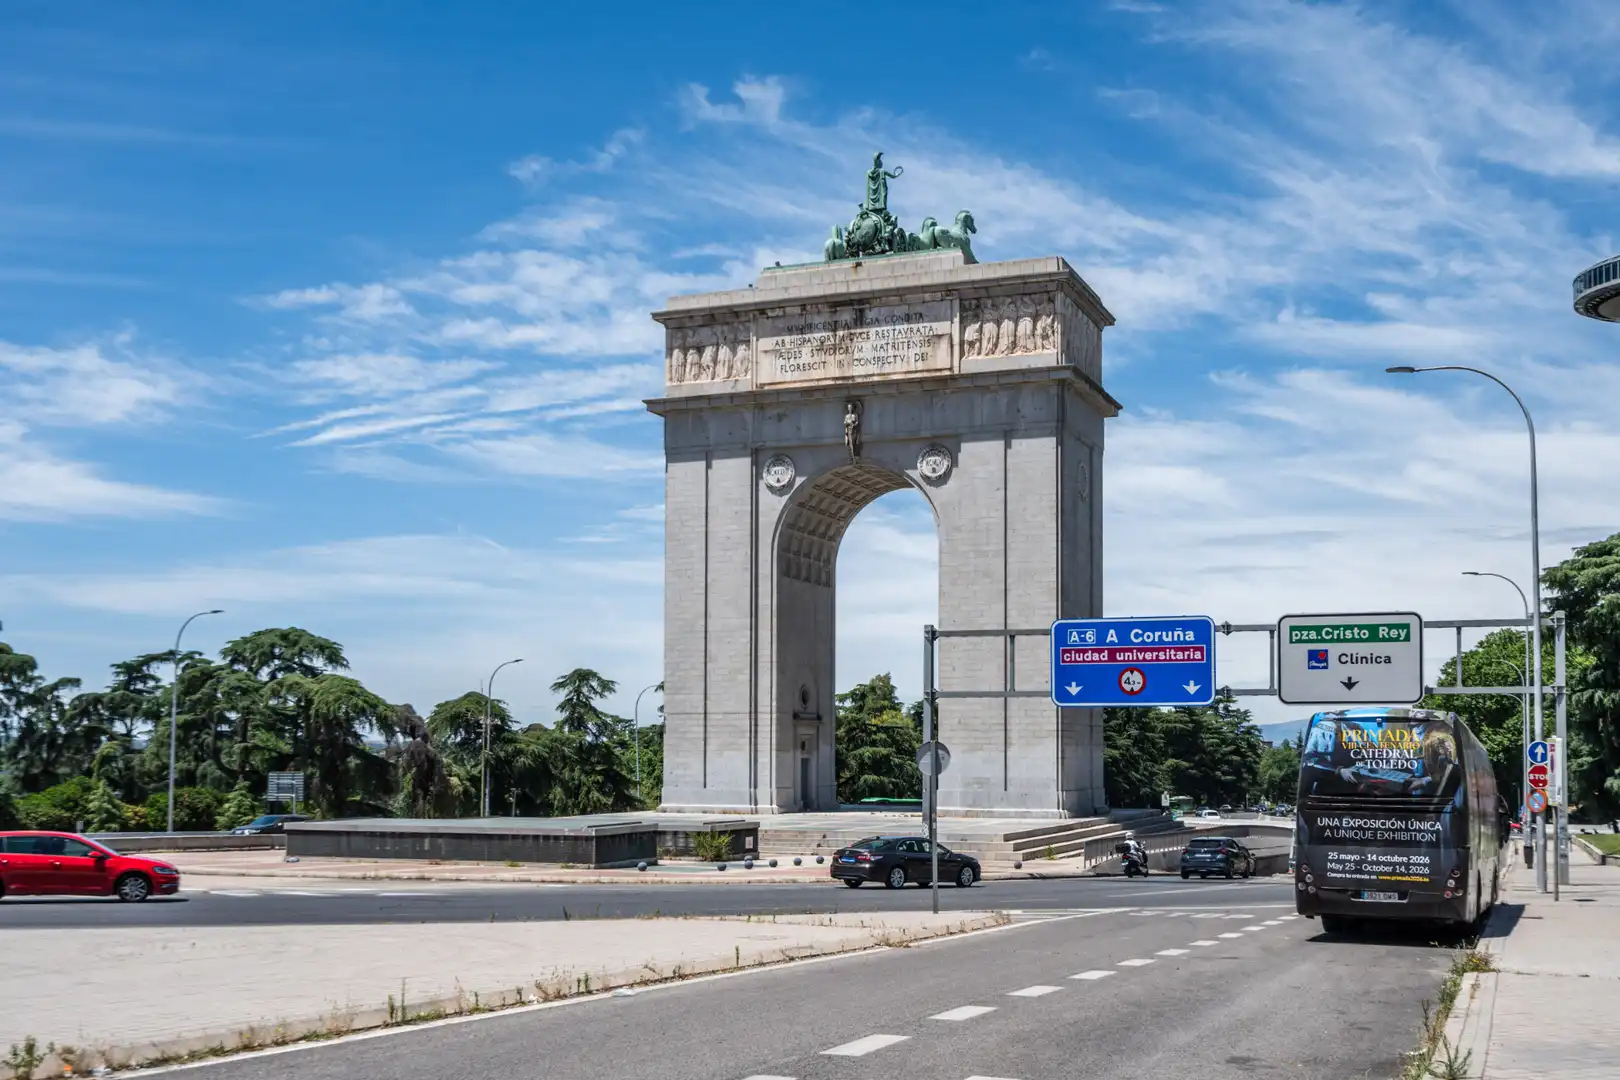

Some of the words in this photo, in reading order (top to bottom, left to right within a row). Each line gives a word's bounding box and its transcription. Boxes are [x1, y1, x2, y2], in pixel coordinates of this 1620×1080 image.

[884, 312, 924, 324] CONDITA
[775, 339, 786, 348] AB
[780, 361, 827, 373] FLORESCIT
[837, 360, 845, 369] IN
[853, 354, 906, 367] CONSPECTV
[1069, 630, 1095, 643] A-6
[1106, 629, 1119, 643] A
[1130, 627, 1195, 643] Coruña
[1292, 627, 1369, 641] pza.Cristo
[1378, 626, 1407, 640] Rey
[1063, 649, 1109, 661] ciudad
[1116, 648, 1202, 661] universitaria
[1338, 652, 1392, 665] Clínica
[1342, 728, 1420, 742] PRIMADA
[1359, 741, 1420, 750] CENTENARIO
[1350, 748, 1418, 759] CATEDRAL
[1365, 759, 1418, 769] TOLEDO
[1317, 817, 1340, 827] UNA
[1342, 817, 1405, 829] EXPOSICIÓN
[1408, 818, 1442, 831] ÚNICA
[1324, 828, 1332, 837] A
[1334, 829, 1375, 839] UNIQUE
[1377, 830, 1436, 841] EXHIBITION
[1328, 852, 1338, 860] 25
[1340, 853, 1360, 861] mayo
[1367, 853, 1377, 861] 14
[1378, 854, 1408, 863] octubre
[1409, 855, 1430, 864] 2026
[1327, 862, 1343, 871] May
[1345, 862, 1355, 870] 25
[1362, 863, 1393, 872] October
[1396, 865, 1407, 873] 14,
[1409, 866, 1430, 874] 2026
